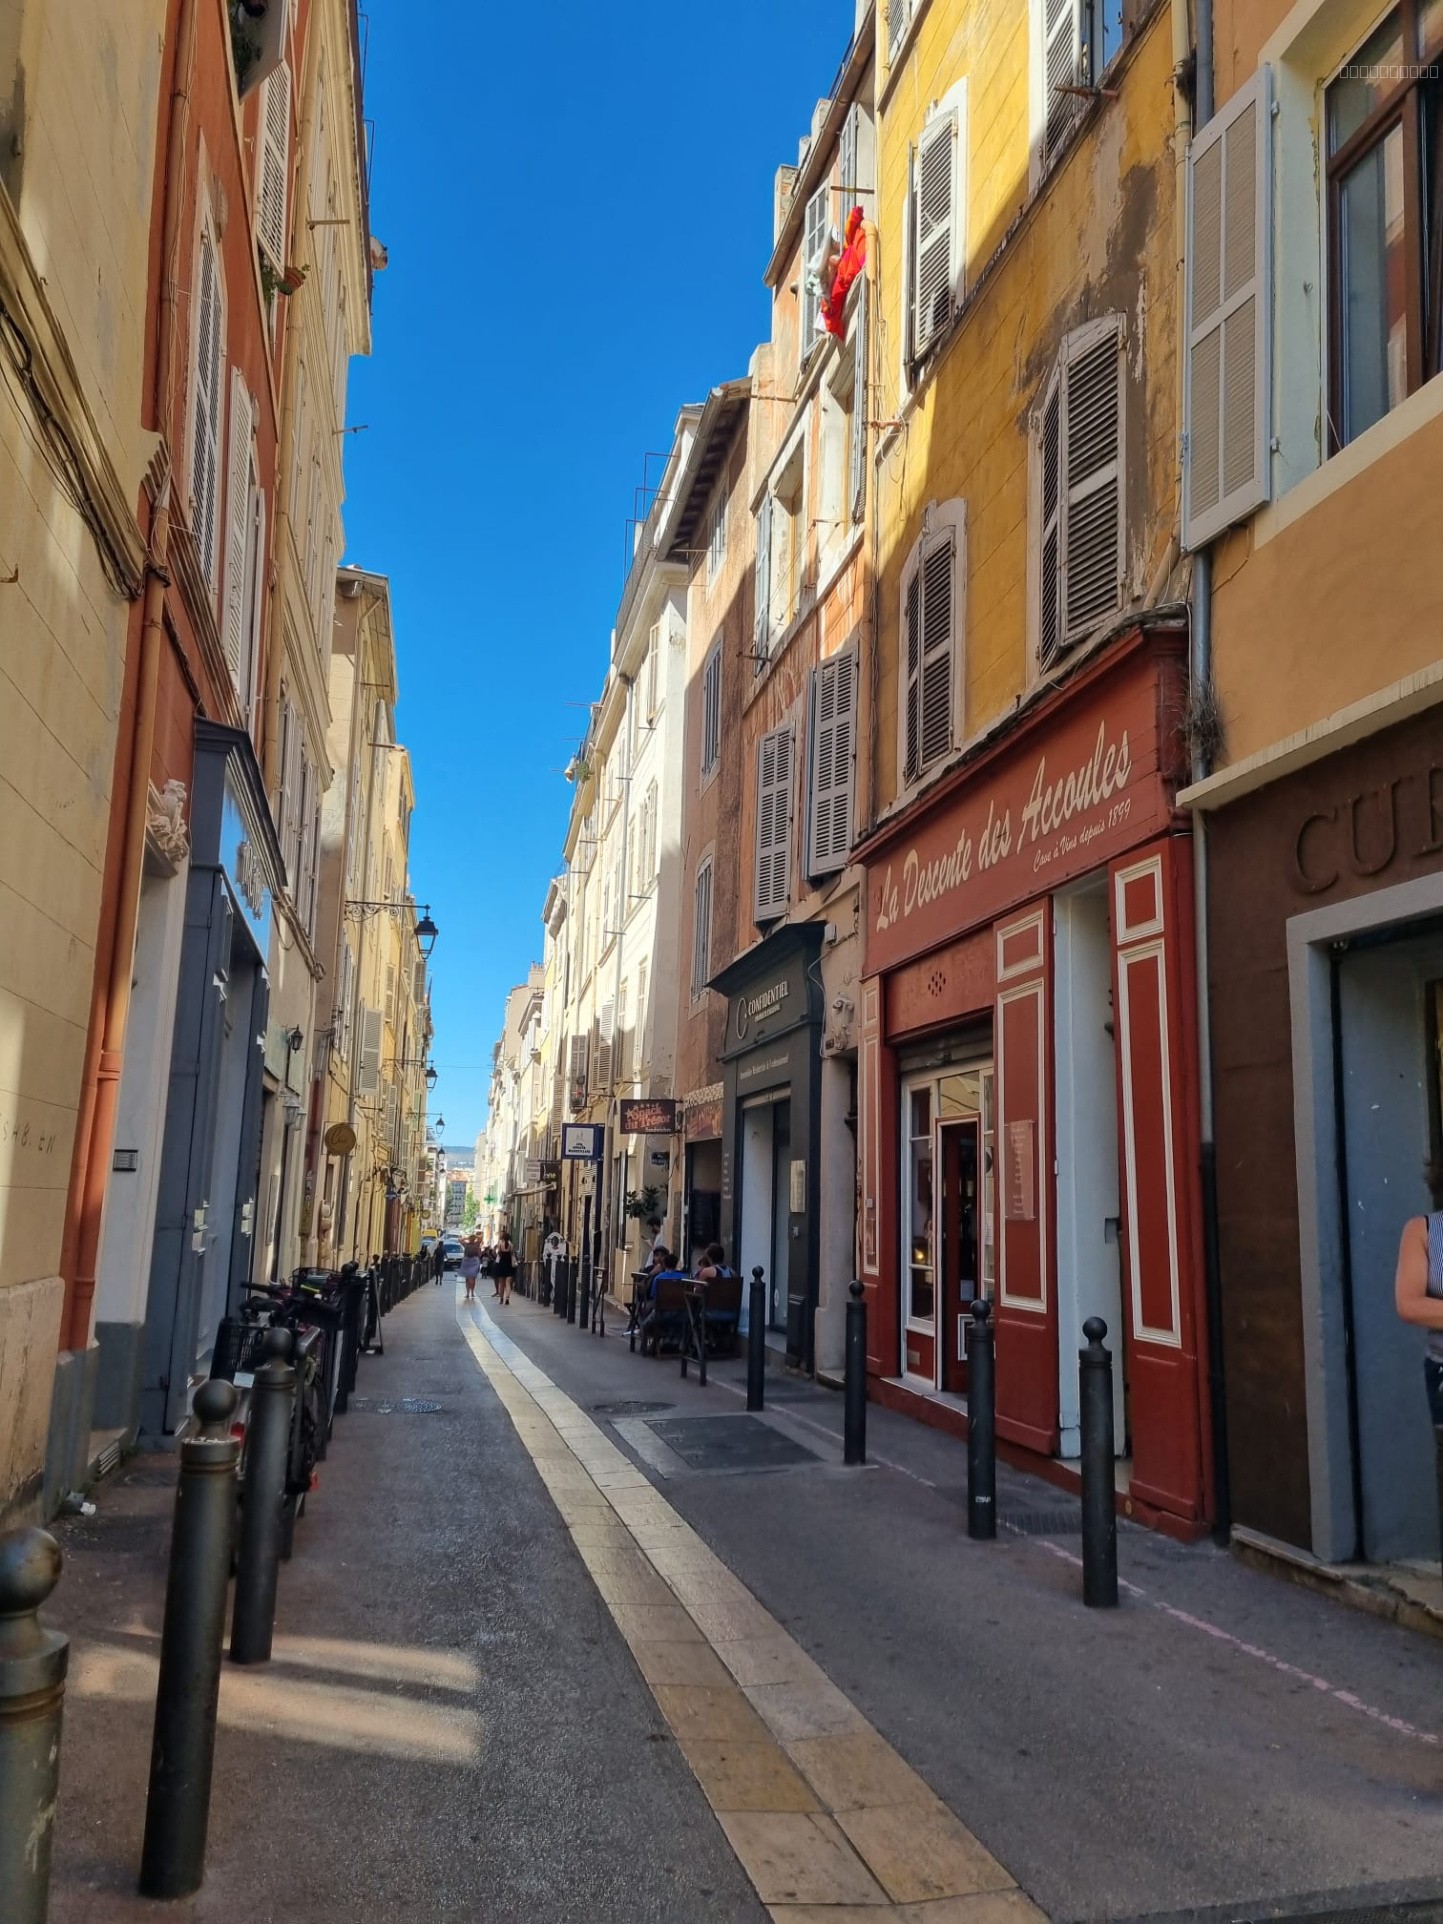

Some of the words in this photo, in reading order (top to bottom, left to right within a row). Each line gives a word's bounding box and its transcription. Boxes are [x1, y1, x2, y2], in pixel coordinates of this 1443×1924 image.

[876, 864, 899, 933] La
[903, 828, 972, 917] Descente
[978, 799, 1012, 871] des
[1017, 720, 1132, 855] Accoules
[1060, 835, 1077, 855] Vins
[1079, 819, 1106, 846] depuis
[1108, 798, 1131, 829] 1899
[747, 980, 789, 1016] CONFIDENTIEL
